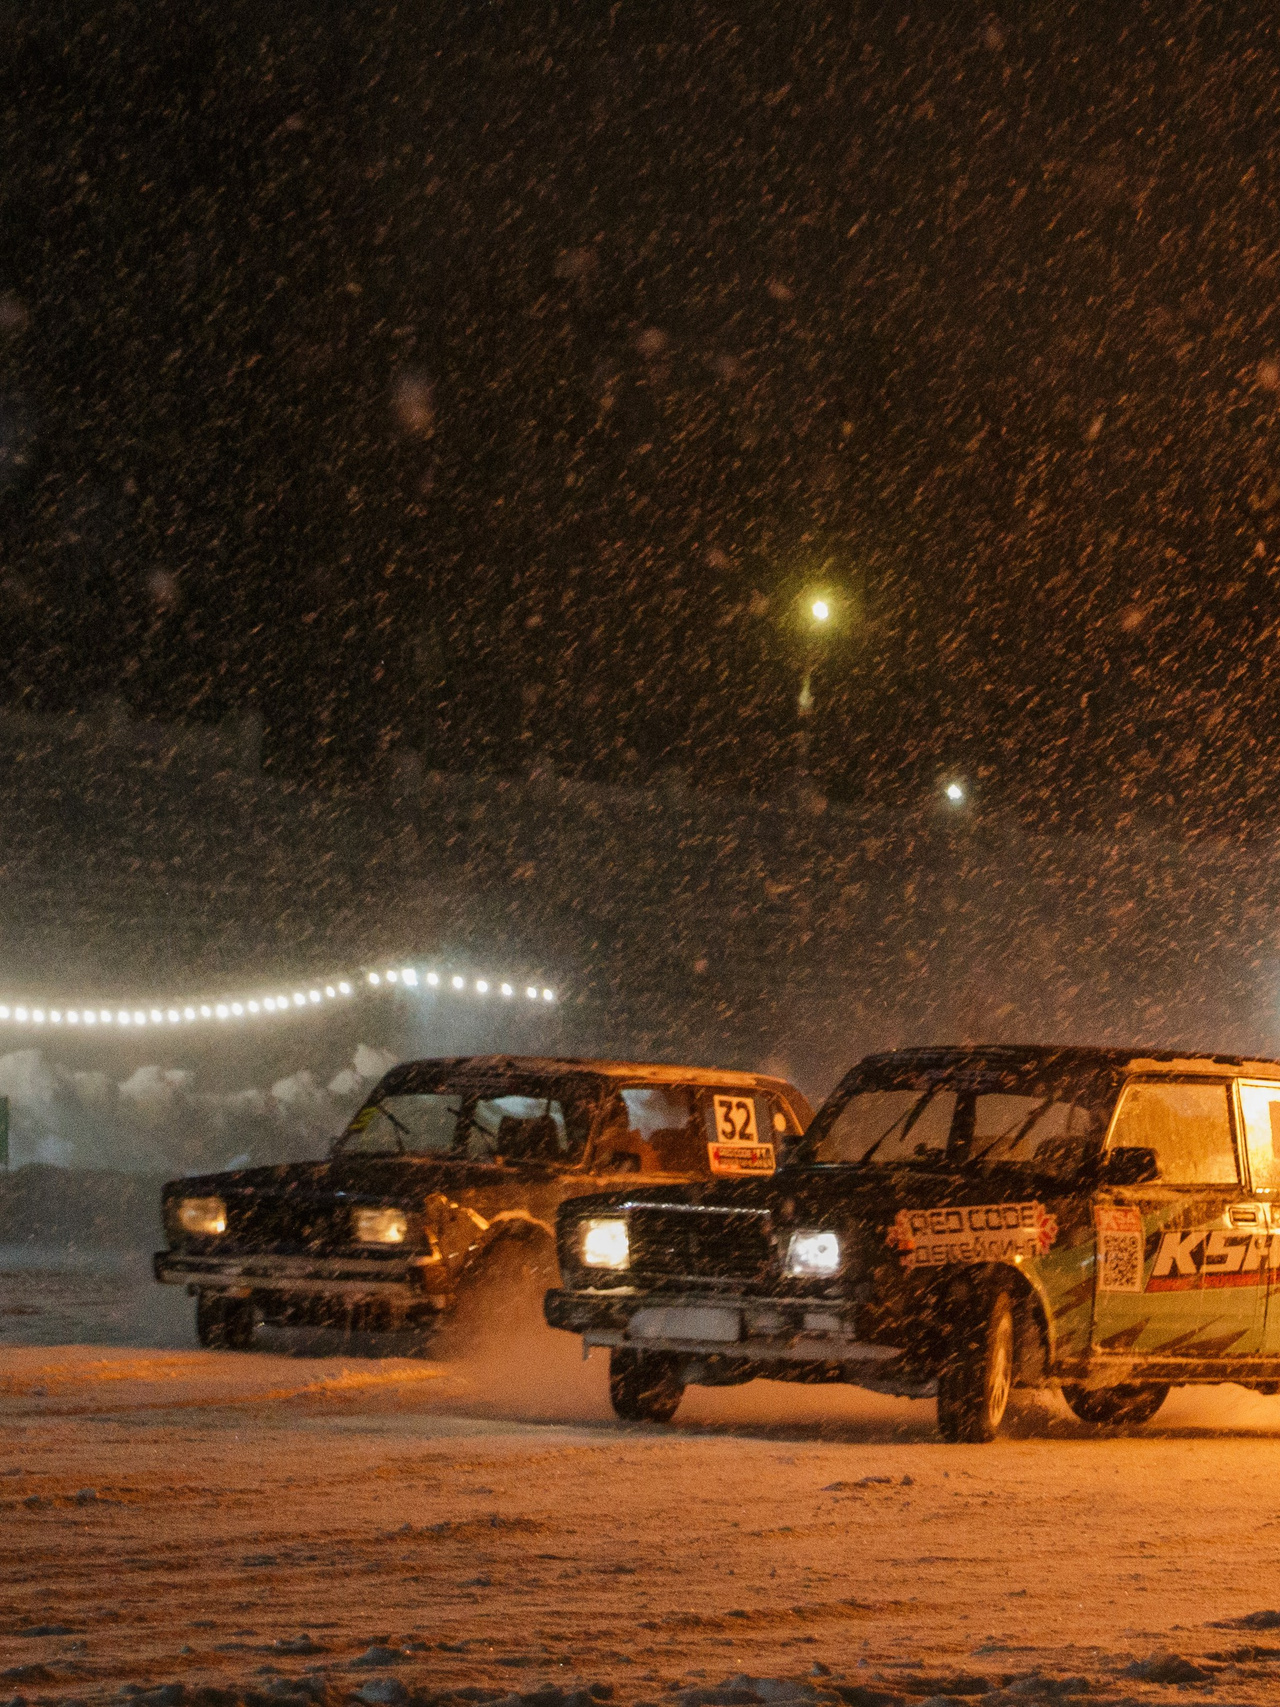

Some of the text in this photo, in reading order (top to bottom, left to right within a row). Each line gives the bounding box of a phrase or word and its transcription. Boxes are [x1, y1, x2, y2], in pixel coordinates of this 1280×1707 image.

[719, 1100, 754, 1141] 32
[911, 1204, 1035, 1236] RED CODE
